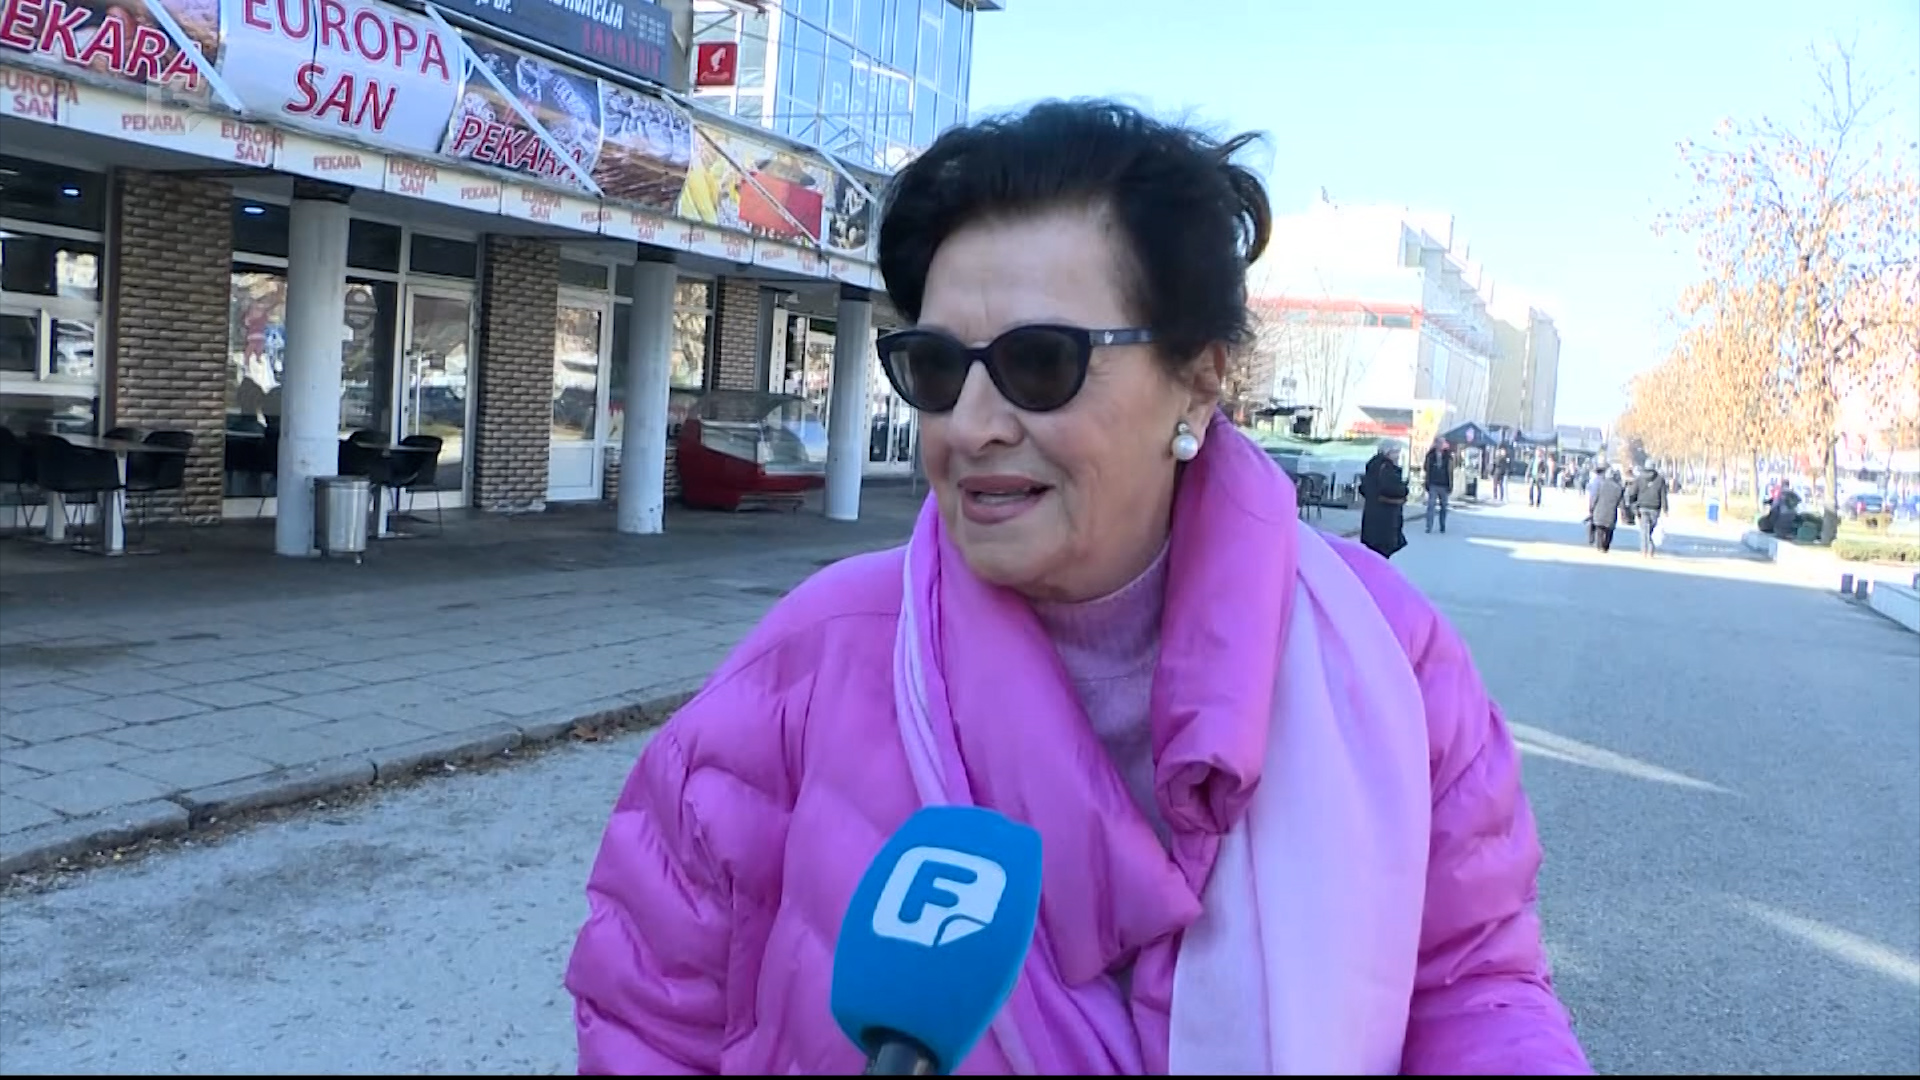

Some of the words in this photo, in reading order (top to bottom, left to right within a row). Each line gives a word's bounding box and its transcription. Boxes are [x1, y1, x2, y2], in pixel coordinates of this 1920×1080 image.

[13, 94, 57, 118] SAN
[286, 62, 397, 131] SAN
[121, 113, 186, 132] PEKARA
[221, 119, 285, 149] EUROPA
[235, 143, 267, 164] SAN
[313, 155, 362, 171] PEKARA
[389, 156, 438, 183] EUROPA
[400, 176, 425, 196] SAN
[461, 184, 498, 200] PEKARA
